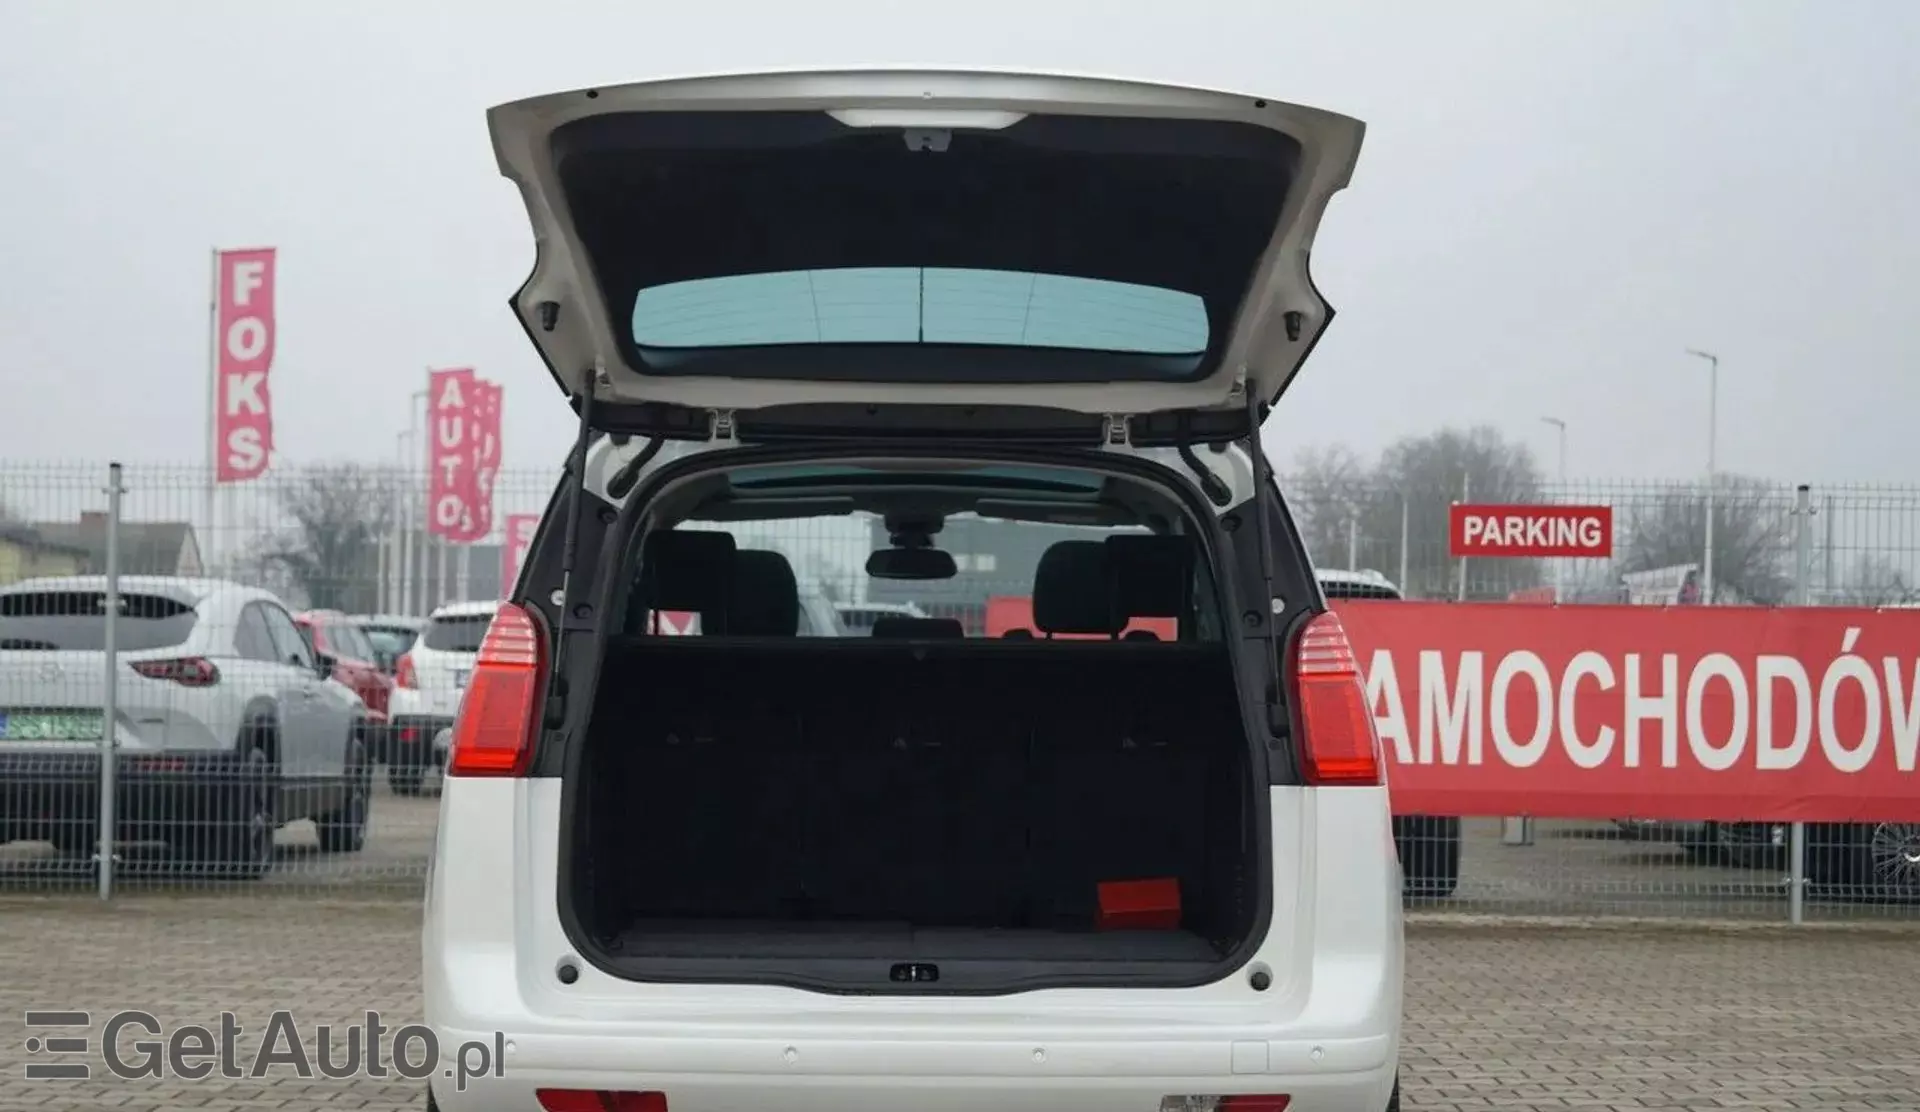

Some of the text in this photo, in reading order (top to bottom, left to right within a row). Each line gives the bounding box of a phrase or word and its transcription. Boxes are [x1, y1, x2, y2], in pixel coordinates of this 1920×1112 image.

[227, 261, 267, 471] FOKS
[437, 377, 465, 527] AUTO
[1464, 515, 1601, 547] PARKING
